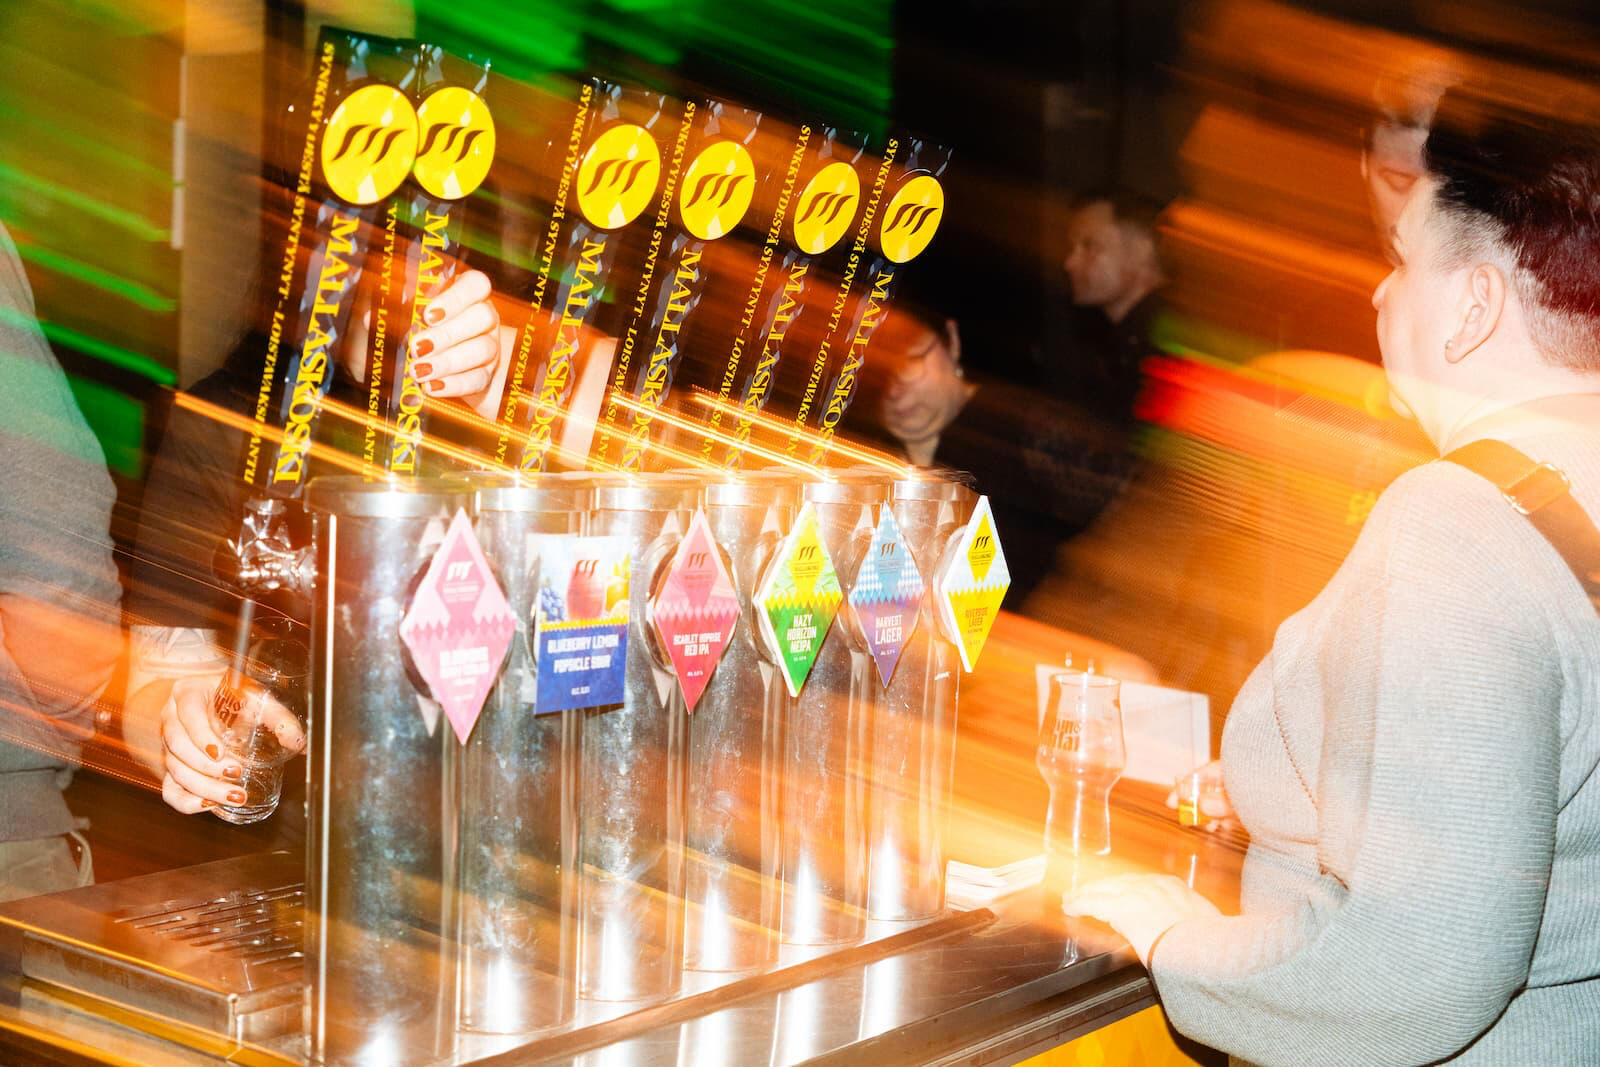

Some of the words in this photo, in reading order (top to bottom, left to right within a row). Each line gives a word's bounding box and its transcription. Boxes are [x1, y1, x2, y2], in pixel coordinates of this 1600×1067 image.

[552, 84, 593, 219] SYNKKYYDESTÄ
[656, 101, 696, 228] SYNKKYYDESTÄ
[767, 124, 811, 245] SYNKKYYDESTÄ
[852, 138, 898, 252] SYNKKYYDESTÄ
[380, 203, 398, 294] YNTYNYT
[531, 220, 560, 312] SYNTYNYT
[632, 229, 663, 317] SYNTYNYT
[742, 246, 774, 329] SYNTYNYT
[828, 253, 860, 332] SYNTYNYT
[273, 214, 360, 483] MALLASKOSKI
[391, 210, 449, 473] MALLOSKI
[520, 238, 607, 473] MALLASKOSKI
[725, 262, 809, 470] MALLASKOSK
[809, 271, 895, 465] MALLASKOSK
[244, 425, 263, 484] ANTU
[875, 614, 902, 628] HARVEST
[875, 626, 902, 645] LAGER
